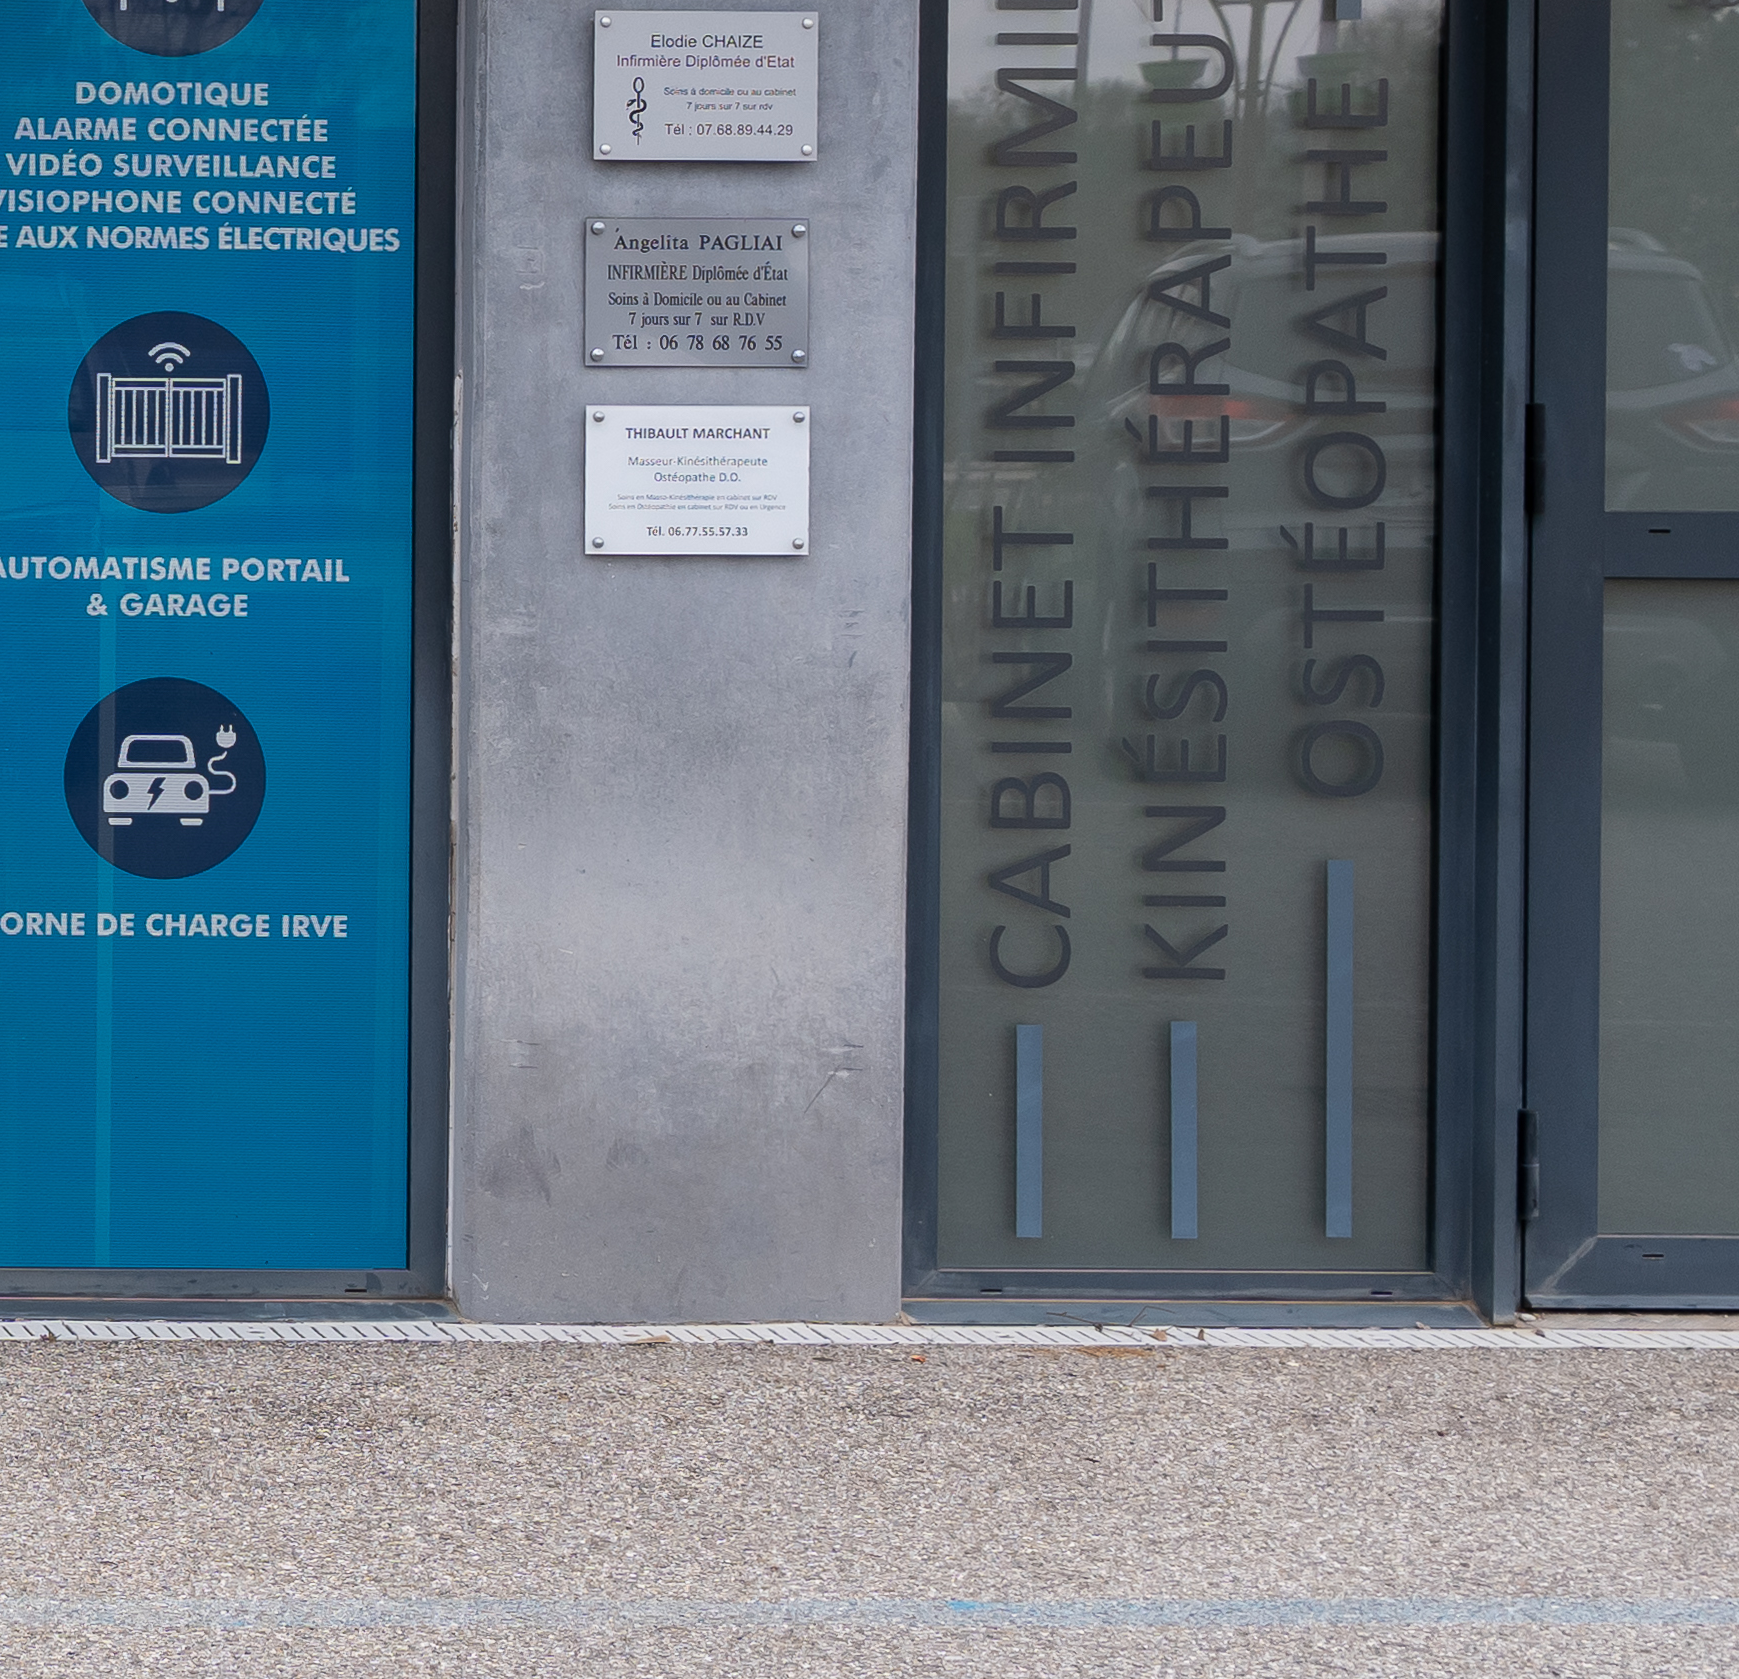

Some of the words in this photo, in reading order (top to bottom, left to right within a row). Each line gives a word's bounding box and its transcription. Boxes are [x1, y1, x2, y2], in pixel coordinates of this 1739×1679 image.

[651, 35, 697, 48] Elodie
[702, 35, 763, 48] CHAIZE
[617, 55, 681, 67] Infirmière
[685, 55, 750, 70] Diplômée
[755, 56, 794, 68] d'Etat
[75, 81, 268, 107] DOMOTIQUE
[14, 117, 136, 141] ALARME
[147, 115, 327, 143] CONNECTÉE
[665, 123, 684, 135] Tél
[697, 124, 793, 136] 07.68.89.44.29
[5, 148, 103, 177] VIDÉO
[113, 153, 335, 179] SURVEILLANCE
[192, 187, 356, 215] CONNECTÉ
[16, 225, 77, 249] AUX
[86, 226, 209, 250] NORMES
[218, 222, 399, 252] ÉLECTRIQUES
[699, 235, 783, 250] PAGLIAI
[608, 261, 687, 280] INFIRMIÈRE
[692, 265, 749, 283] Diplômée
[753, 261, 788, 280] d'État
[608, 292, 638, 306] Soins
[643, 293, 649, 306] à
[654, 292, 702, 306] Domicile
[707, 296, 721, 306] ou
[726, 296, 740, 306] au
[744, 293, 786, 307] Cabinet
[629, 312, 636, 325] 7
[641, 313, 669, 328] jours
[673, 315, 691, 326] sur
[695, 313, 702, 325] 7
[711, 315, 728, 326] sur
[613, 334, 637, 350] Tél
[660, 335, 678, 350] 06
[687, 335, 703, 350] 78
[713, 336, 729, 350] 68
[739, 336, 756, 350] 76
[765, 336, 782, 350] 55
[626, 428, 689, 439] THIBAULT
[693, 428, 770, 439] MARCHANT
[1280, 78, 1388, 798] OSTÉOPATHE
[628, 456, 768, 468] Masseur-Kinésithérapeute
[654, 472, 715, 484] Ostéopathe
[719, 473, 741, 482] D.O.
[647, 526, 665, 537] Tél.
[668, 527, 748, 536] 06.77.55.57.33
[222, 557, 349, 582] PORTAIL
[86, 593, 107, 616] &
[120, 593, 248, 618] GARAGE
[989, 505, 1075, 988] CABINET
[97, 912, 135, 937] DE
[145, 913, 270, 938] CHARGE
[281, 914, 348, 938] IRVE
